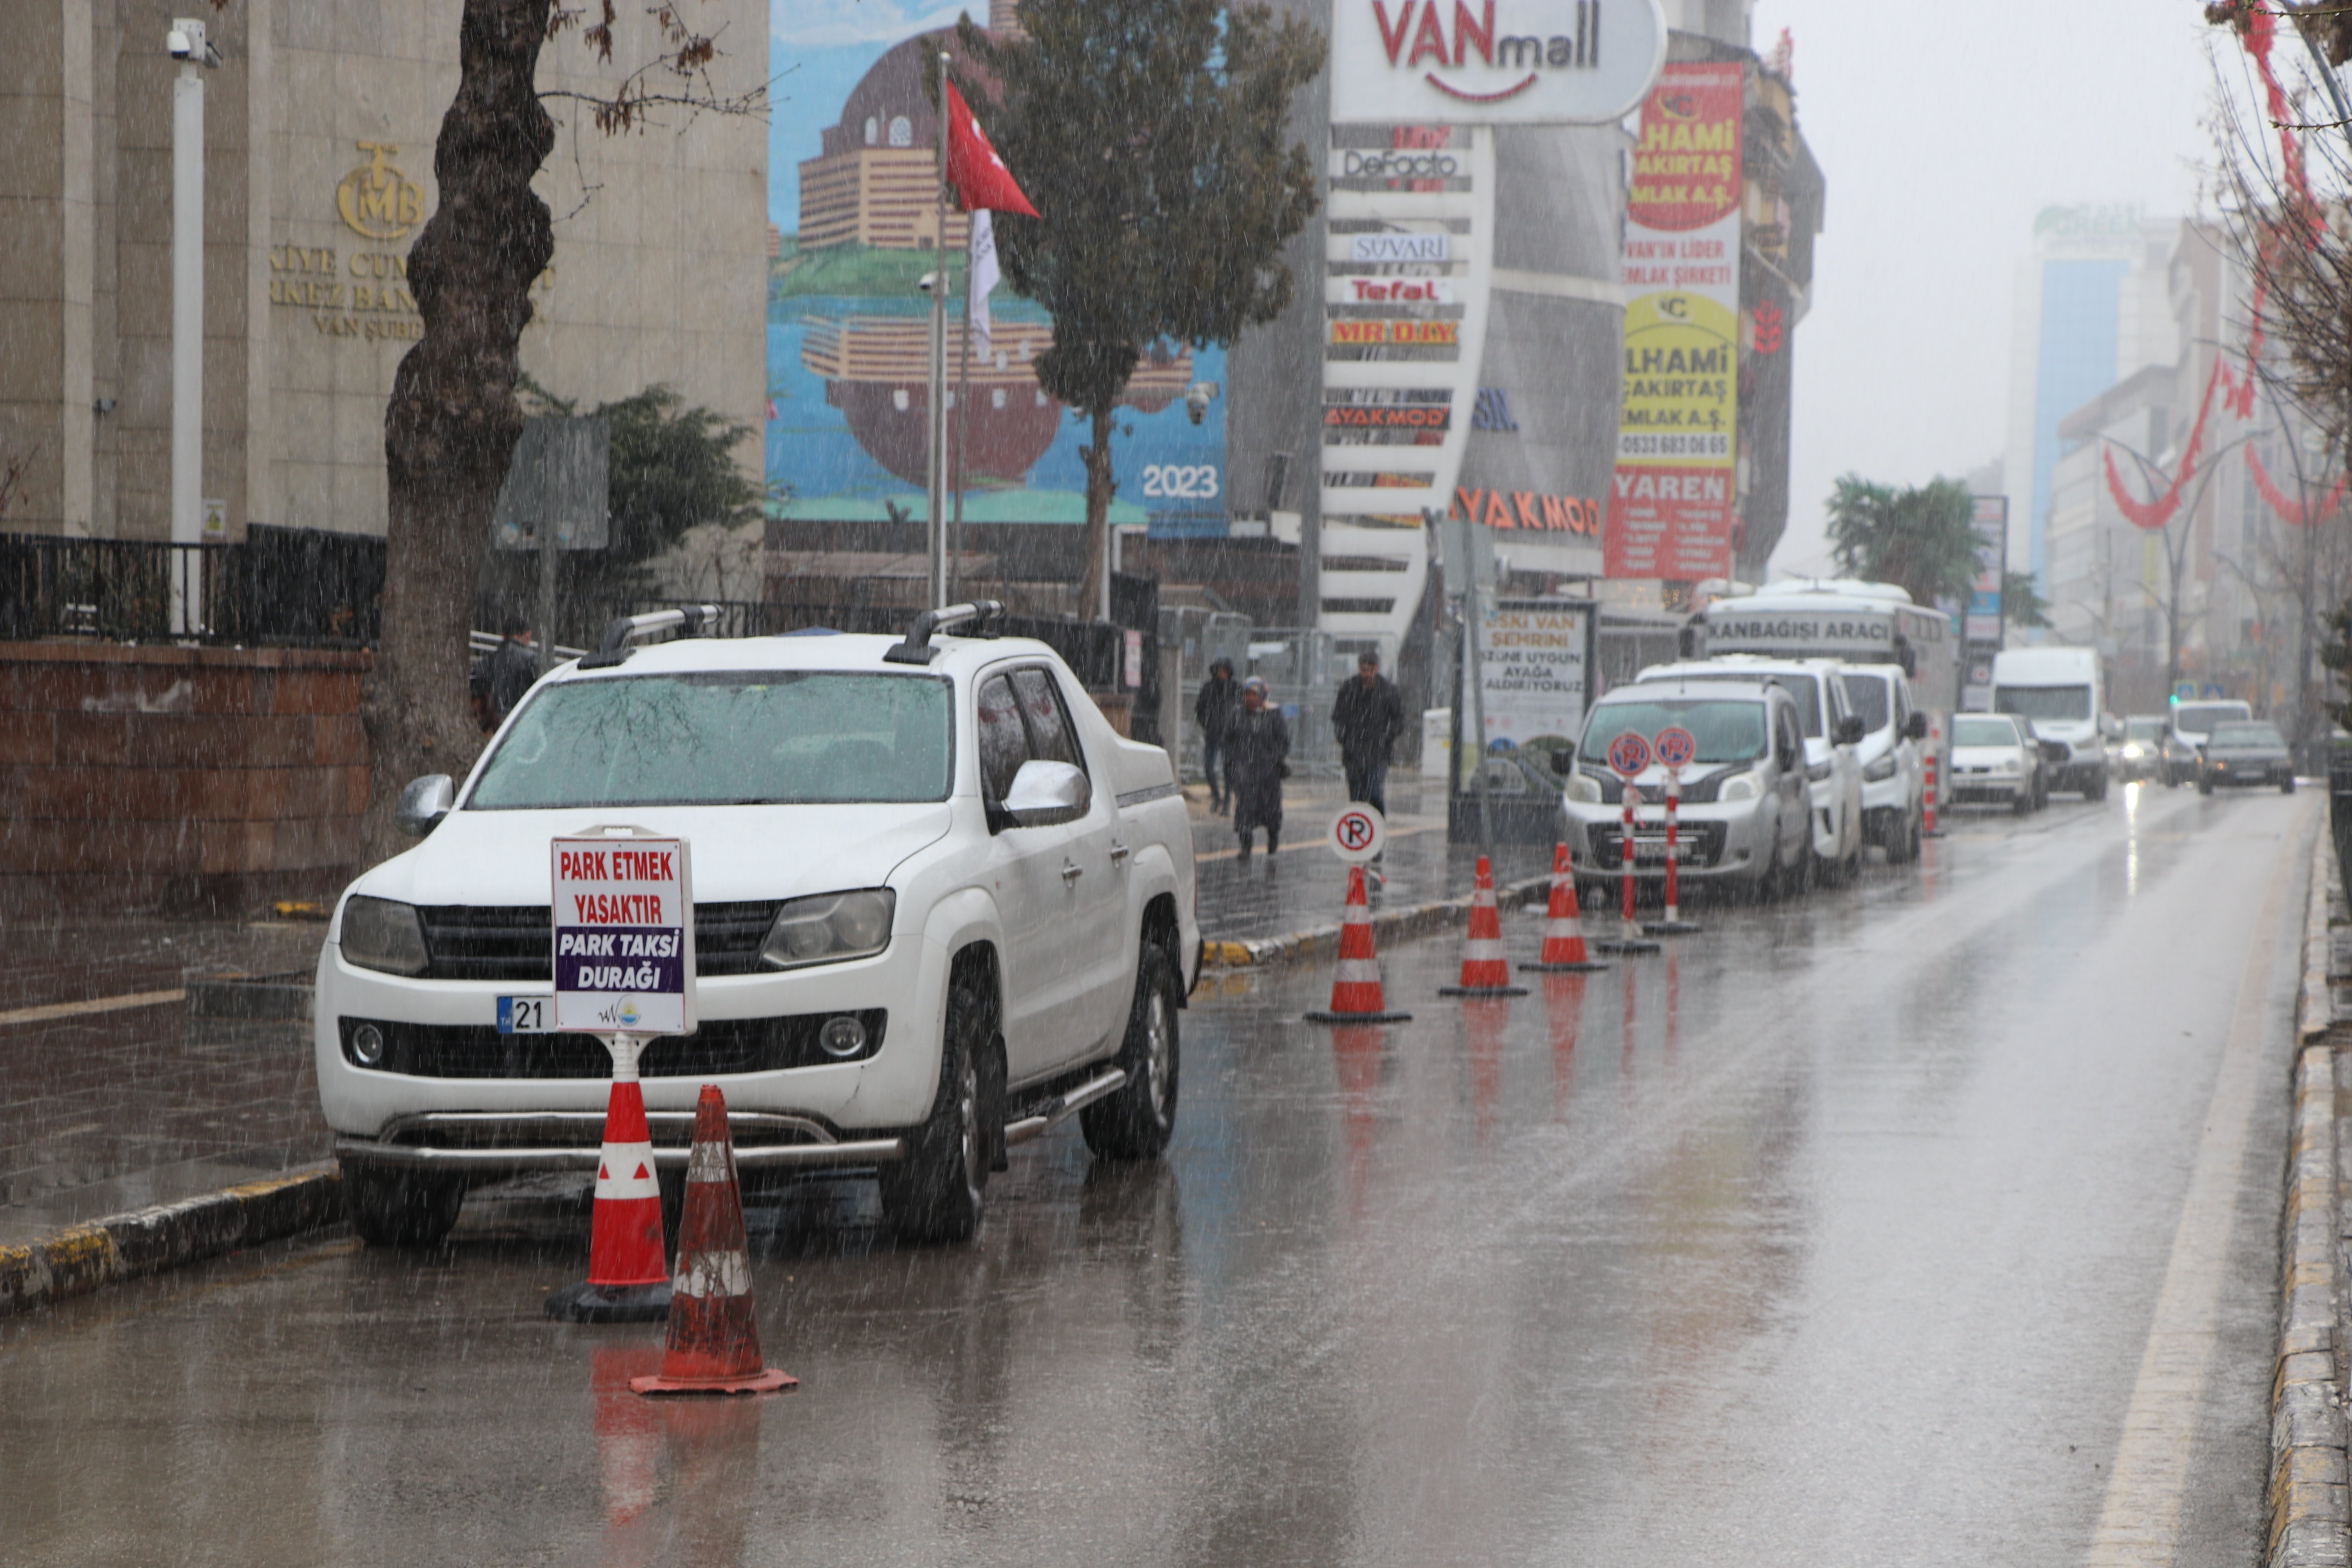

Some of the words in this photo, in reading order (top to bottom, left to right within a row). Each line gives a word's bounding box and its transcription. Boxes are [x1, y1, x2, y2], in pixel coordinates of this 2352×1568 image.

[1637, 119, 1734, 151] HAMİ
[1343, 151, 1457, 177] DeFacto
[1637, 154, 1733, 181] AKIRTAŞ
[1631, 185, 1688, 203] MLAK
[1357, 234, 1444, 258] SÜVARİ
[1681, 236, 1724, 259] LİDER
[1674, 263, 1731, 290] ŞİRKETİ
[1352, 279, 1439, 301] Tefal
[313, 315, 359, 336] VAN
[365, 319, 425, 343] ŞUBE
[1626, 345, 1728, 374] LHAMİ
[1324, 408, 1444, 426] AYAKMOD
[1143, 465, 1219, 498] 2023
[1615, 475, 1724, 500] YAREN
[1536, 615, 1575, 629] VAN
[1825, 622, 1889, 641] ARACI
[1492, 632, 1568, 648] ŞEHRİNİ
[1527, 652, 1581, 664] UYGUN
[1504, 665, 1553, 678] AYAĞA
[1486, 679, 1583, 692] ALDIRIYORUZ
[1349, 820, 1365, 843] P
[561, 852, 608, 880] PARK
[612, 852, 673, 880] ETMEK
[574, 895, 662, 924] YASAKTIR
[559, 933, 614, 956] PARK
[619, 929, 680, 958] TAKSİ
[577, 961, 661, 989] DURAĞI
[515, 1001, 542, 1029] 21
